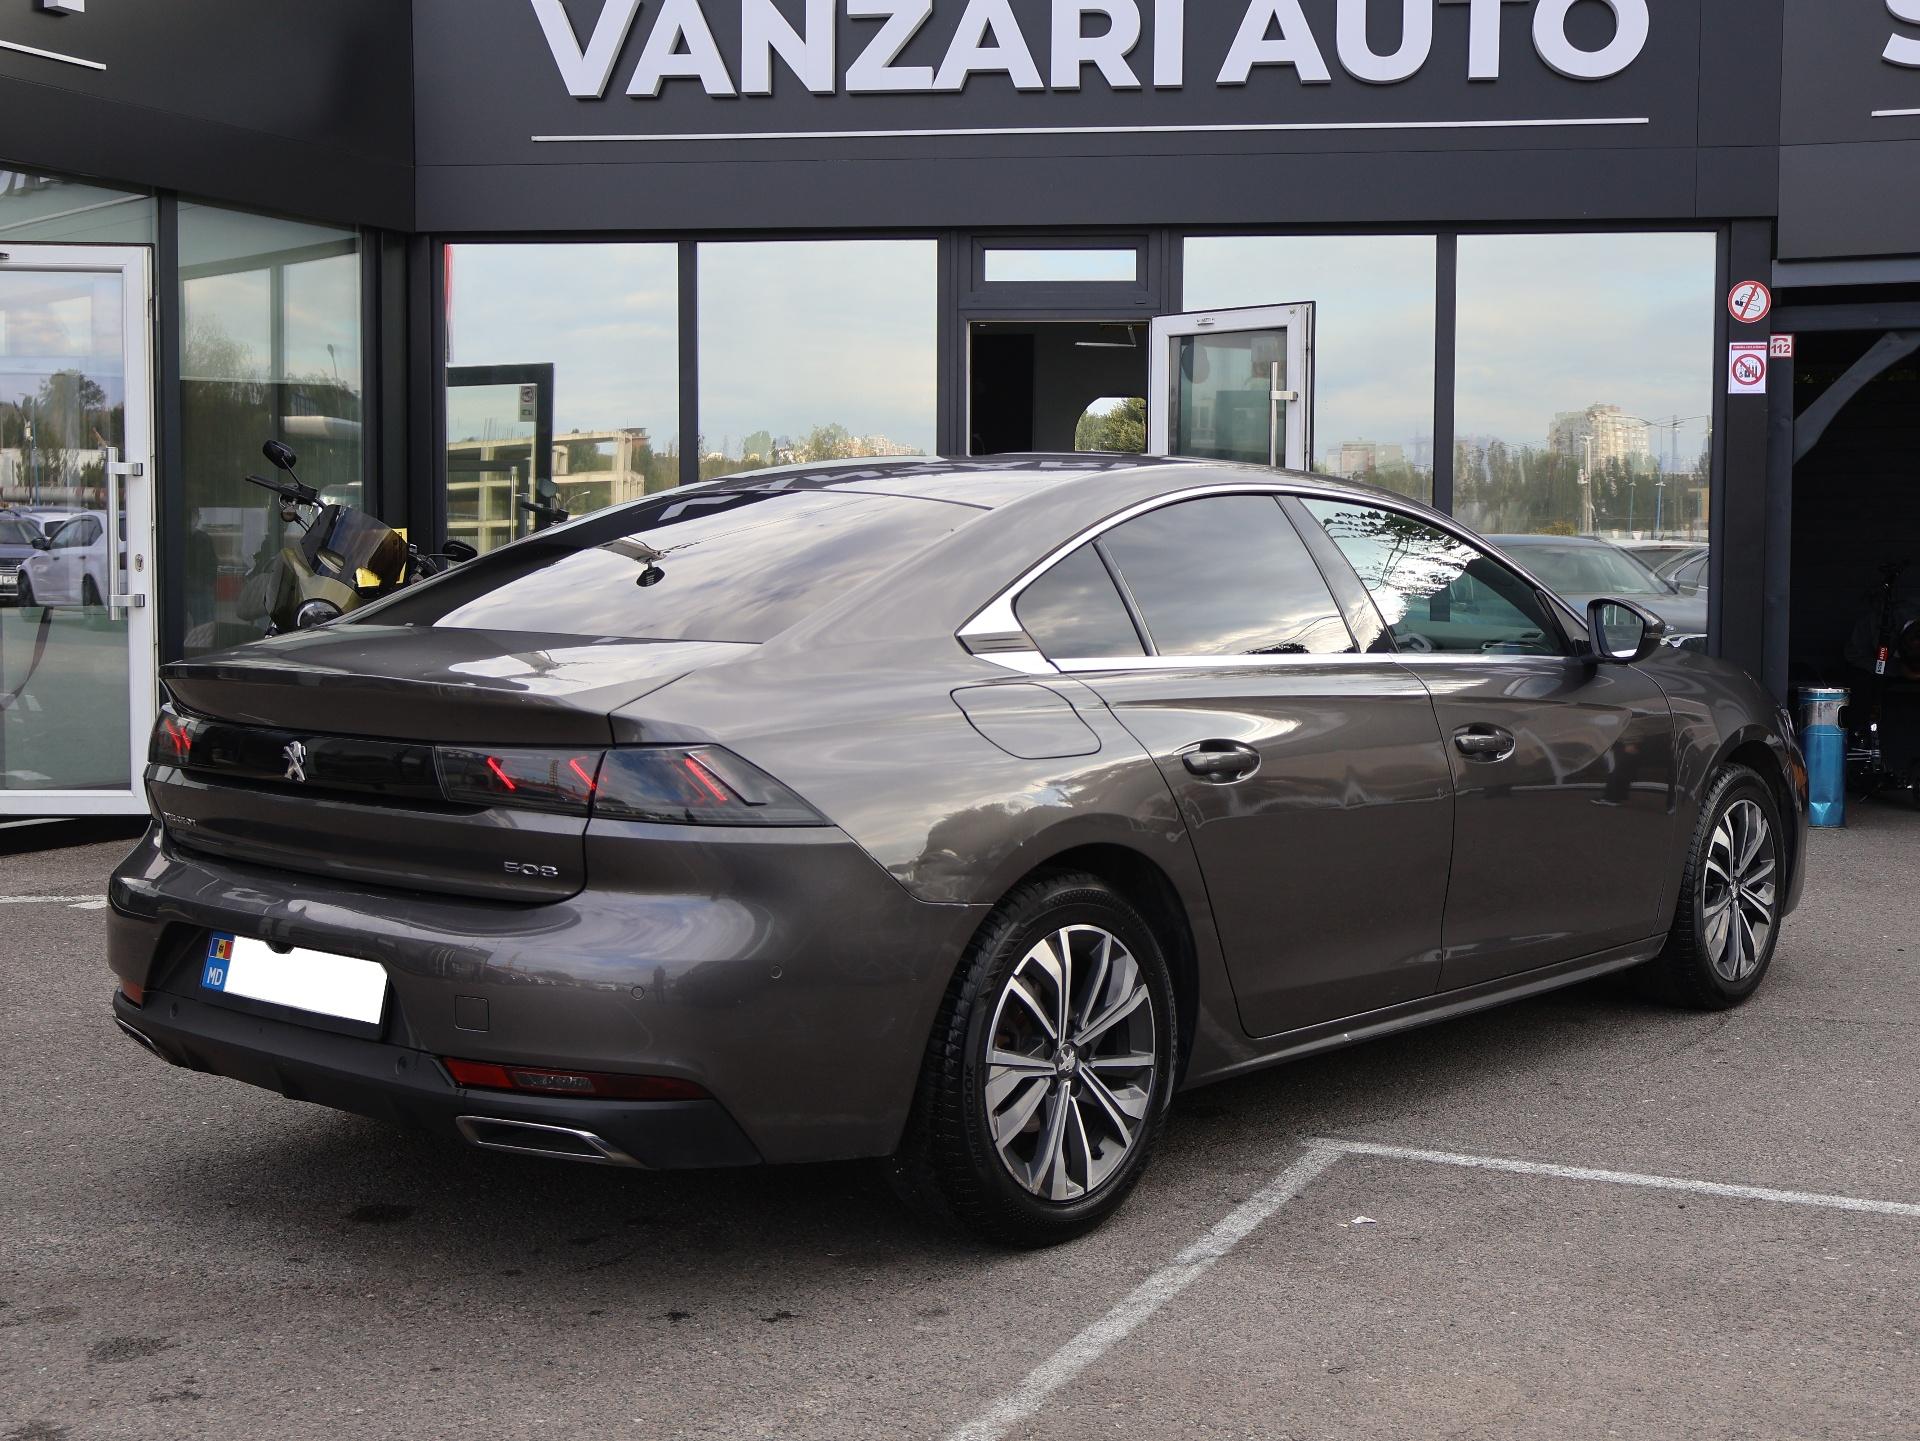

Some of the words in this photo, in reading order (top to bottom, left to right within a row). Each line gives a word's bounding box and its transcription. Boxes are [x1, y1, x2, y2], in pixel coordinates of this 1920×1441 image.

[530, 0, 1184, 98] VANZARI
[1215, 0, 1650, 86] AUTO
[1771, 344, 1791, 354] 112
[503, 861, 559, 877] 508
[206, 966, 223, 985] MD
